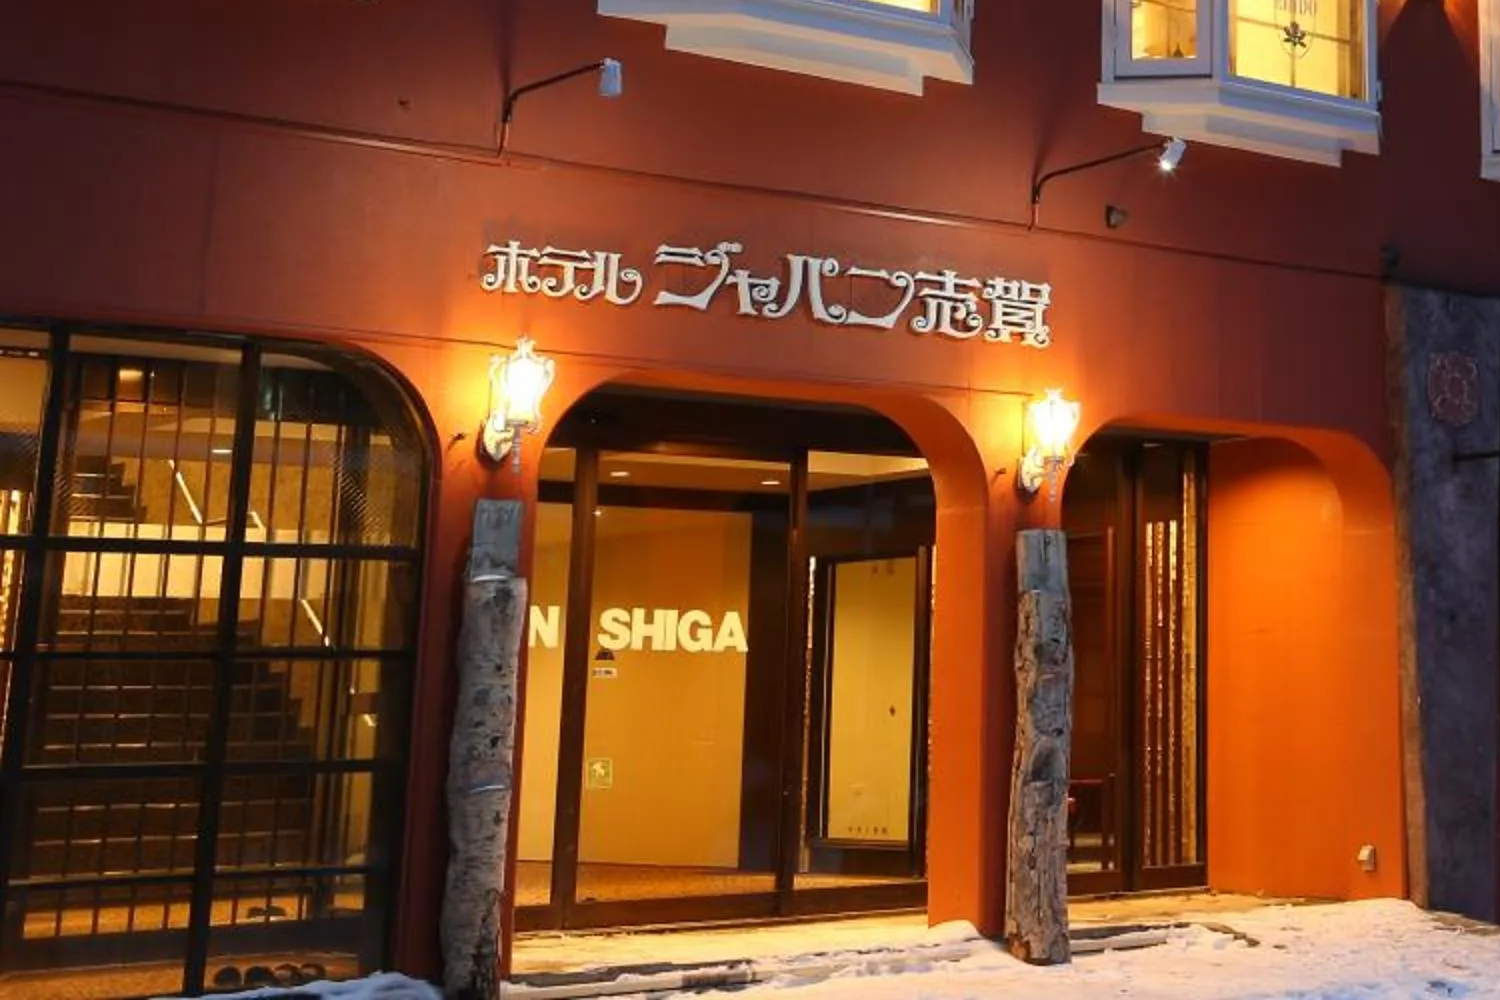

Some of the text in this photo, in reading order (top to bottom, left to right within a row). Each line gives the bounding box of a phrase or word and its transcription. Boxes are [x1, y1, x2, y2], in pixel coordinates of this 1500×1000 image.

[480, 240, 643, 305] ホテル
[597, 607, 748, 653] SHIGA
